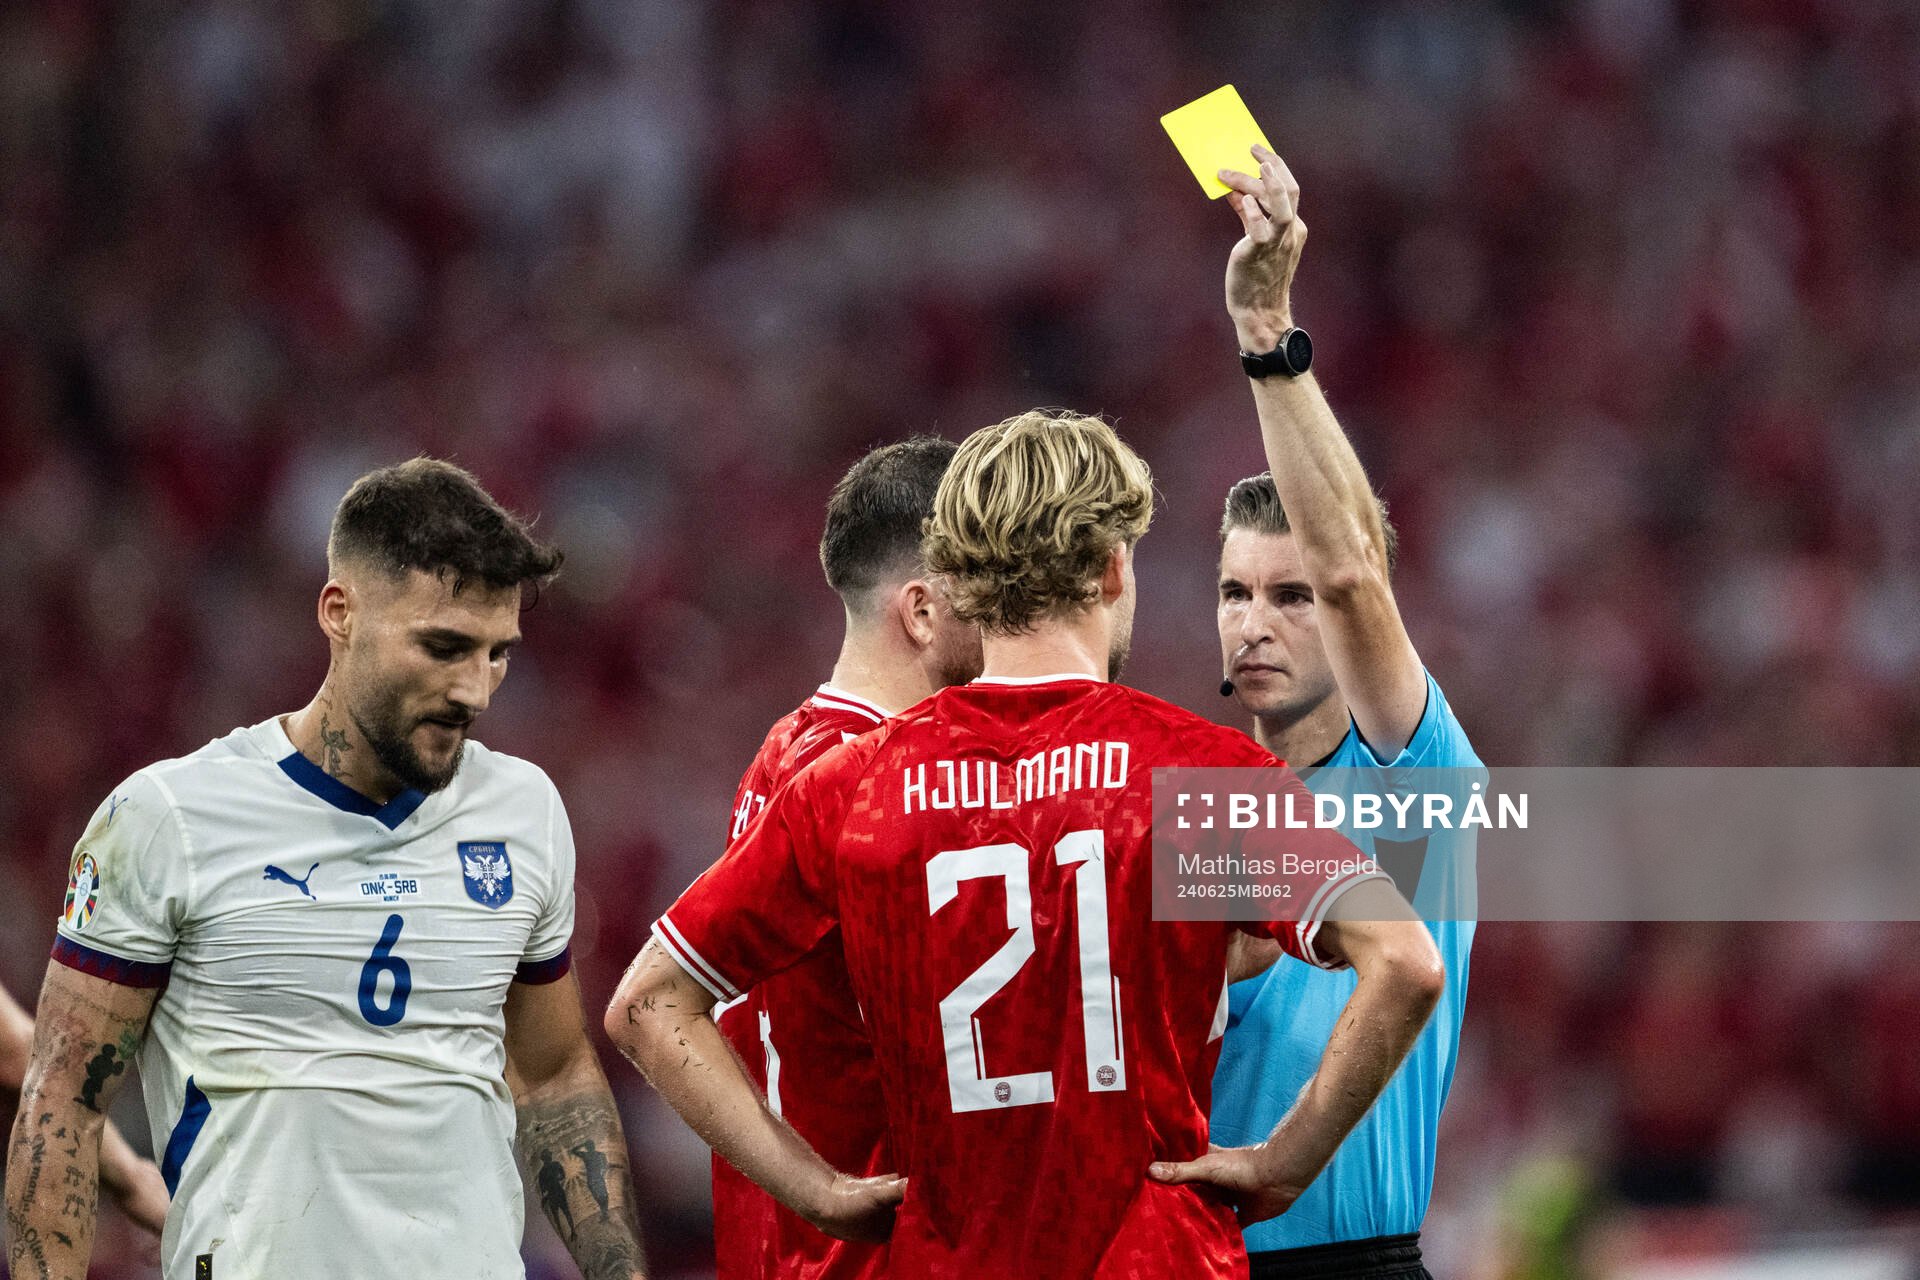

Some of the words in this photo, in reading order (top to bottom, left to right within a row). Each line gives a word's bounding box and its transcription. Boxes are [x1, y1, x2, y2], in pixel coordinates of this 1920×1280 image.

[903, 741, 1129, 814] HJULMAND
[357, 913, 412, 1027] 6
[925, 829, 1127, 1114] 21
